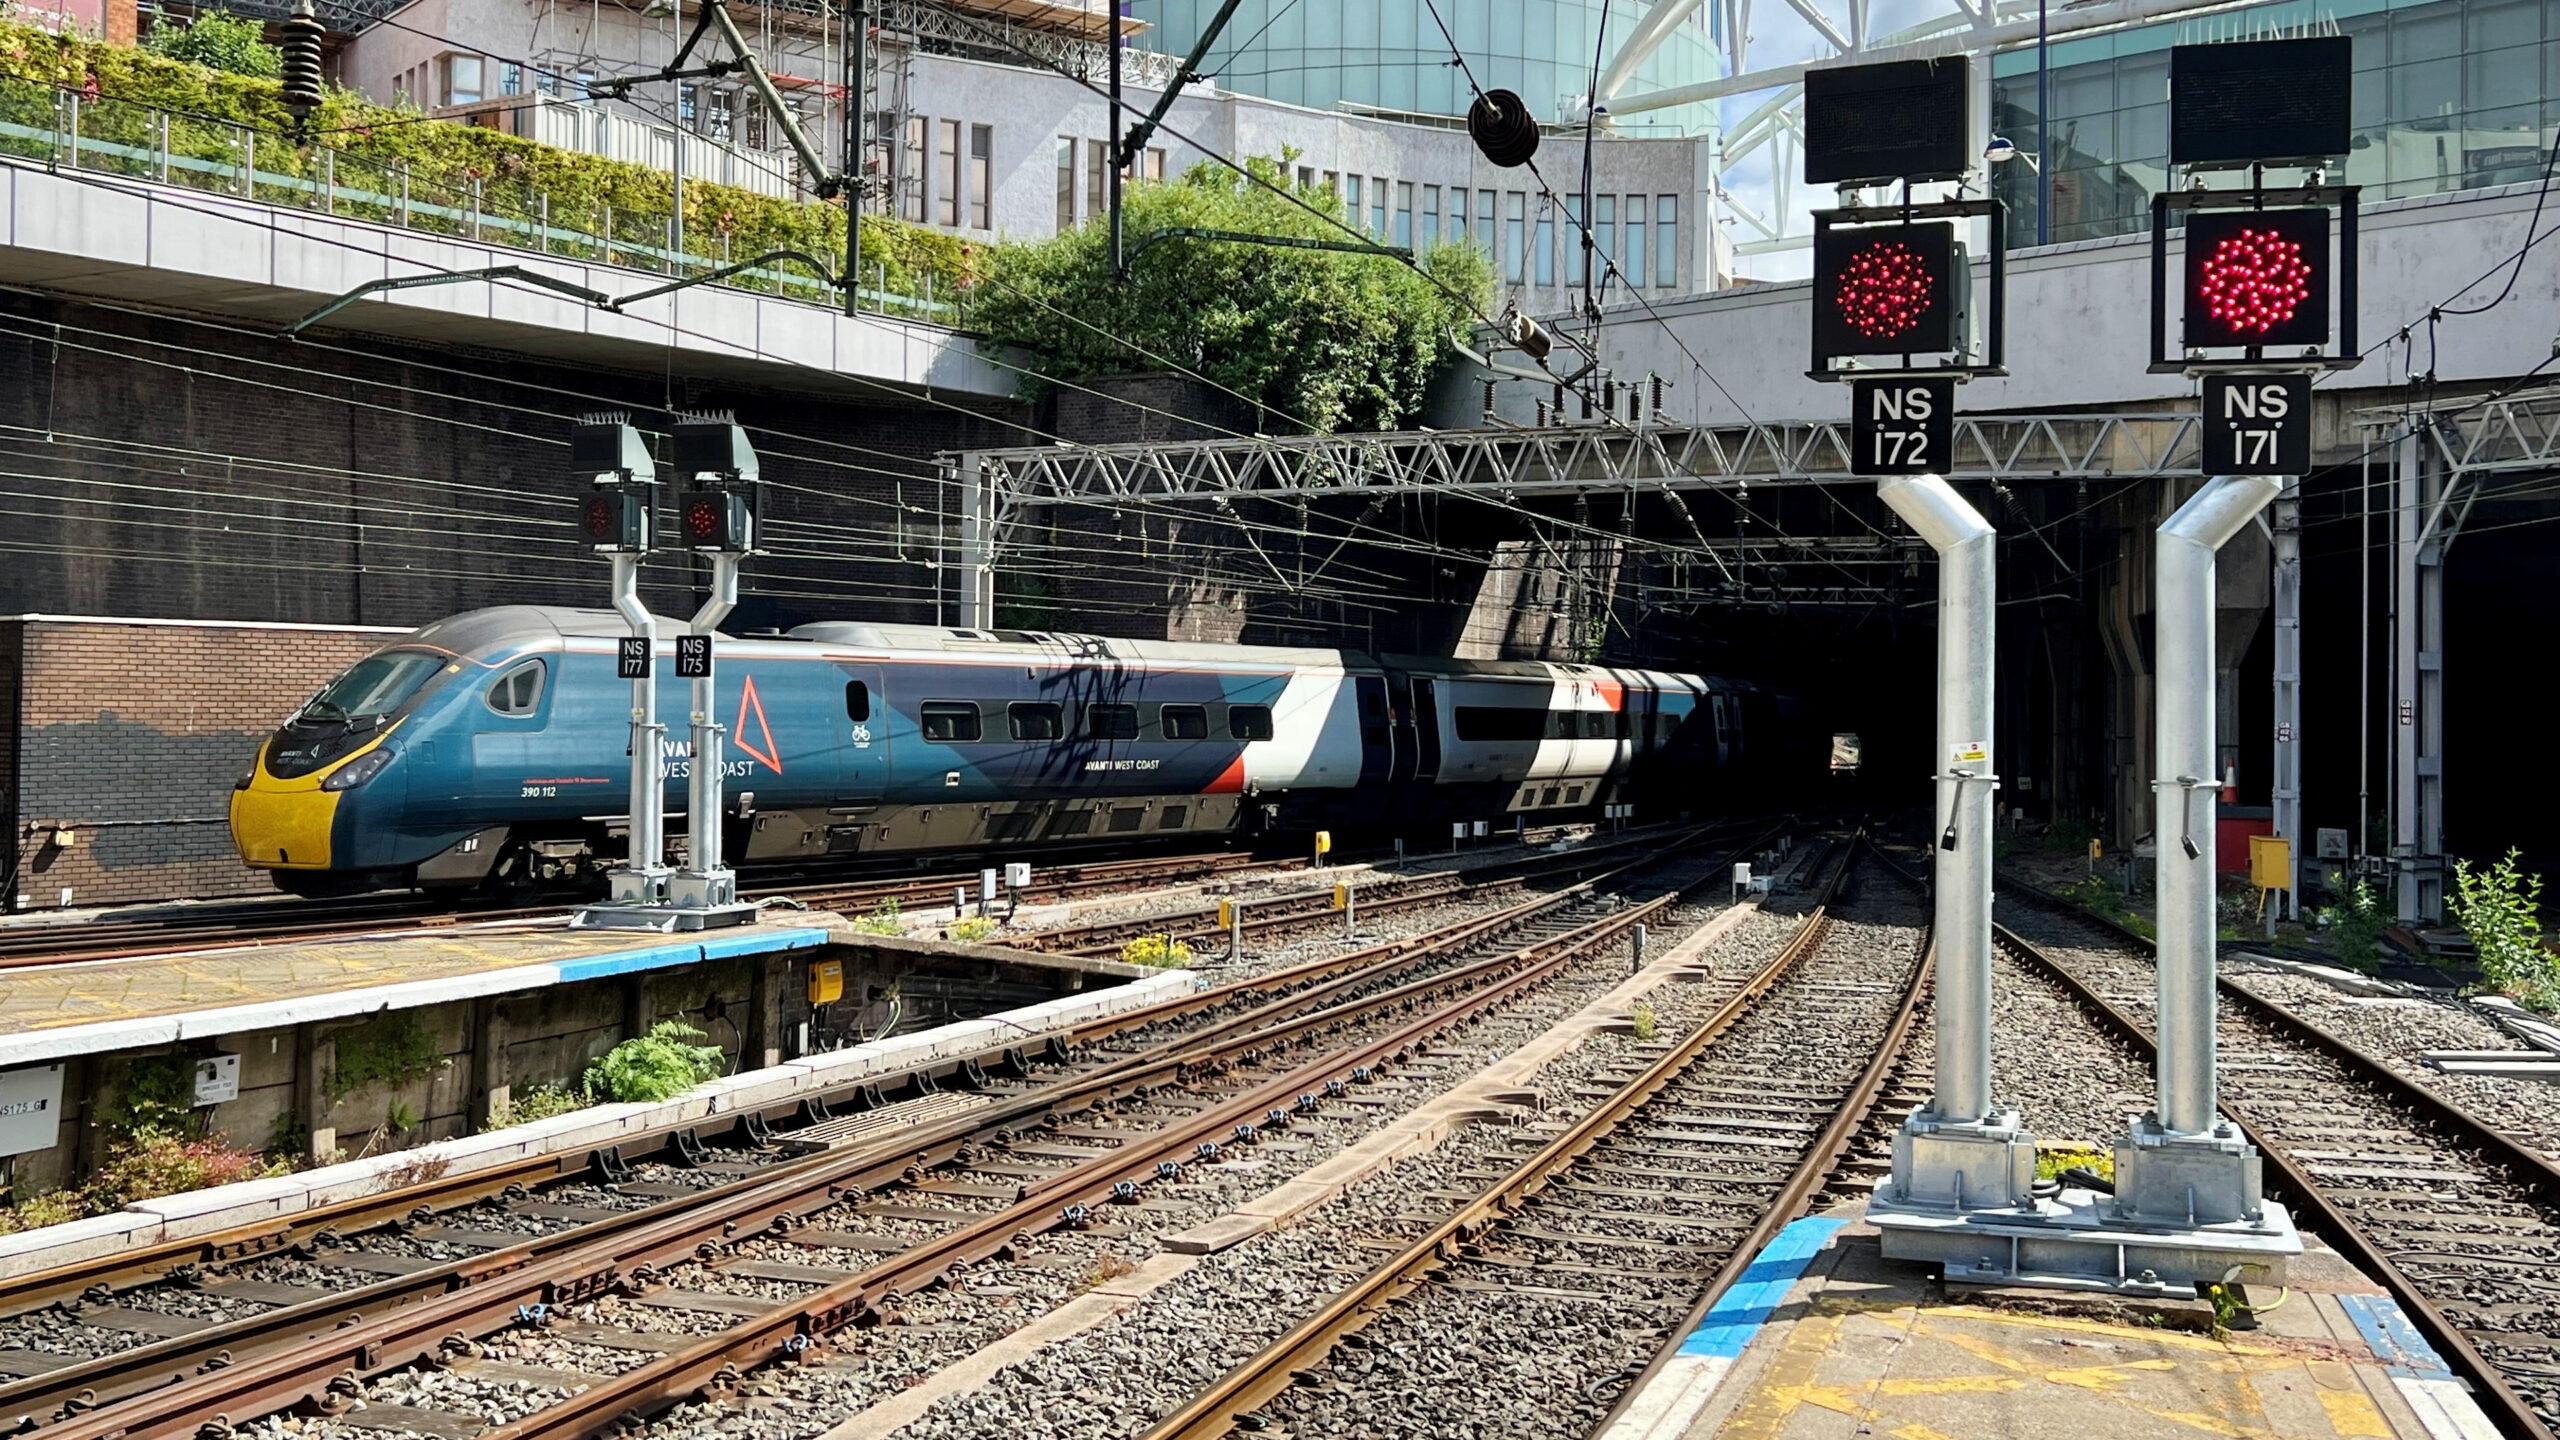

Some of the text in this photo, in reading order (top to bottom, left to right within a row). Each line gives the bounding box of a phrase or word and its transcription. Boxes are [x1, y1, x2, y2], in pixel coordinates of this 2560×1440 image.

[1873, 387, 1932, 420] NS
[2224, 385, 2288, 418] NS
[1874, 431, 1928, 465] 172
[2235, 430, 2277, 464] 171
[624, 641, 644, 656] NS
[682, 639, 704, 654] NS
[624, 659, 643, 674] 177
[682, 658, 704, 673] 175
[1085, 759, 1159, 771] AVANTI WEST COAST
[521, 786, 556, 797] 390 112
